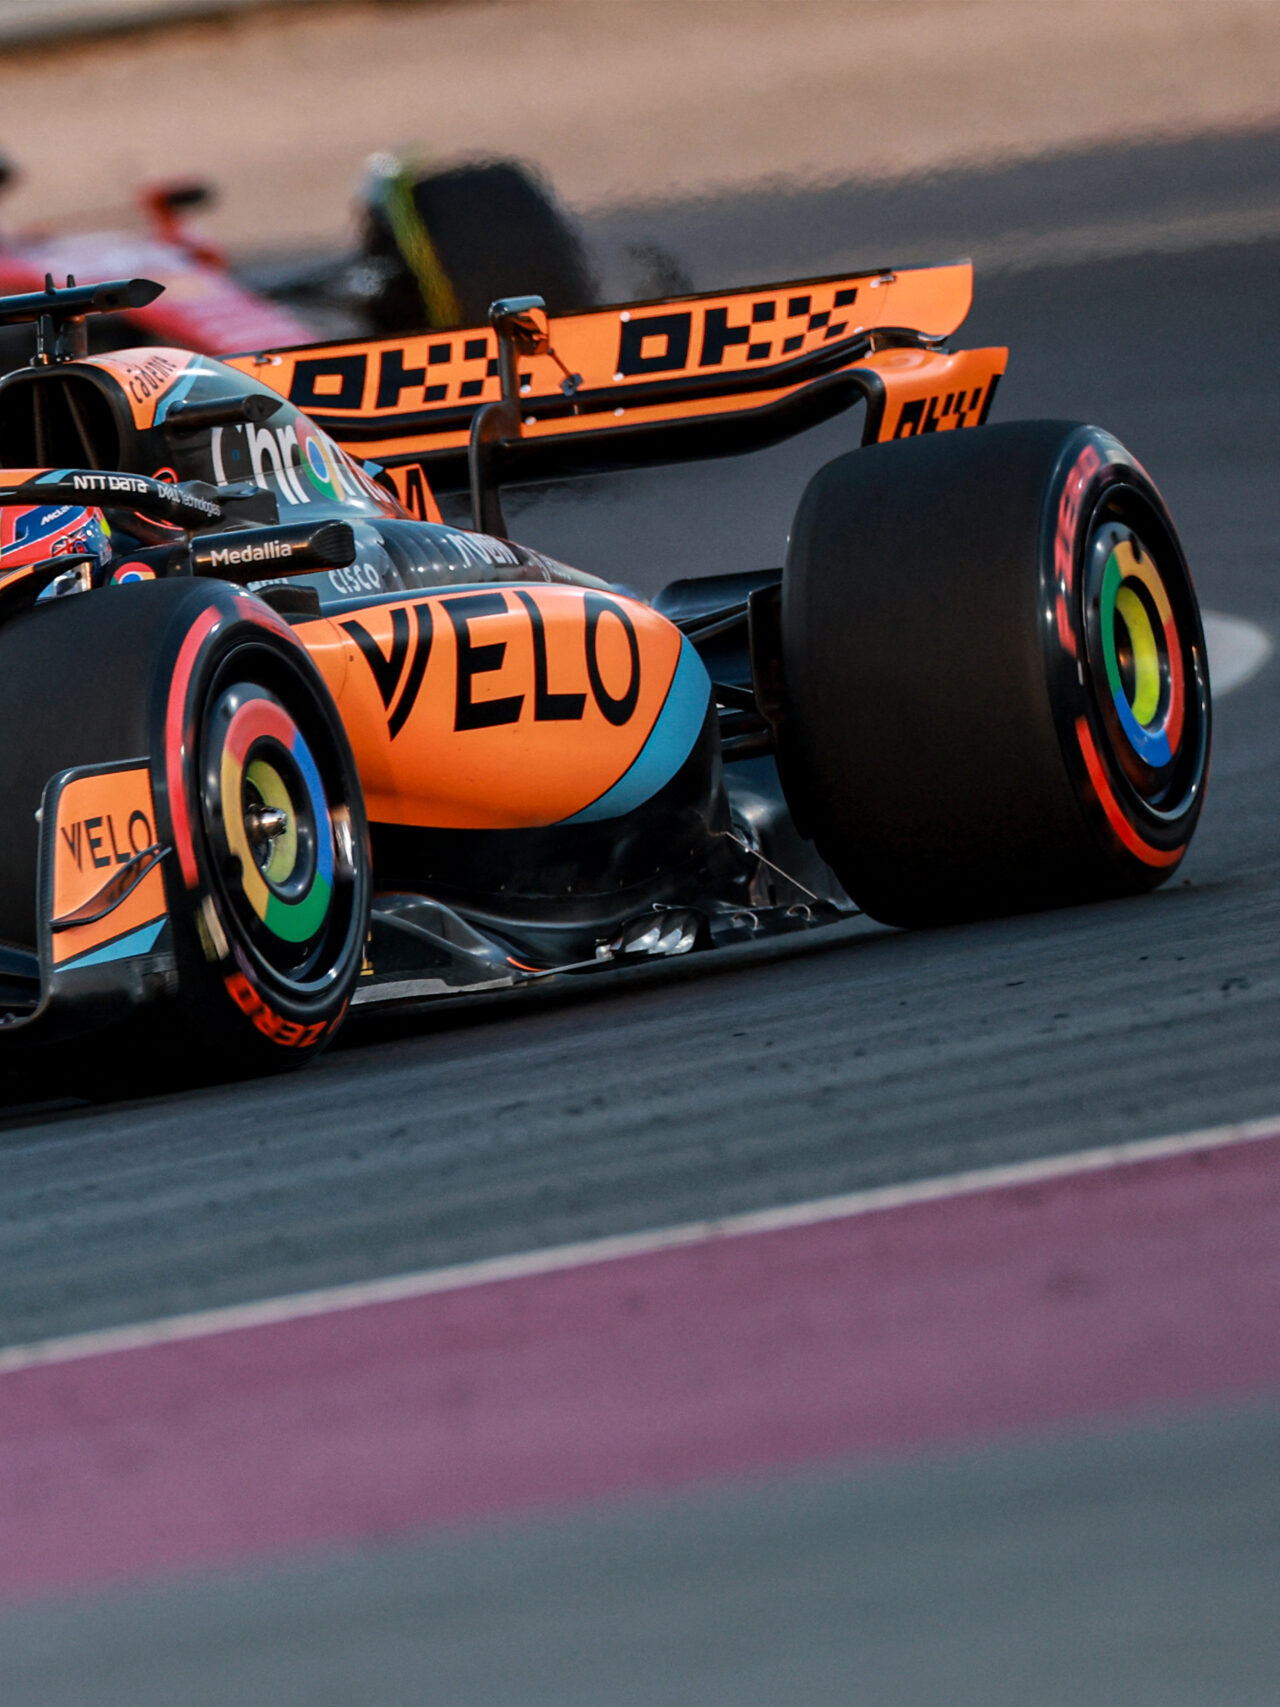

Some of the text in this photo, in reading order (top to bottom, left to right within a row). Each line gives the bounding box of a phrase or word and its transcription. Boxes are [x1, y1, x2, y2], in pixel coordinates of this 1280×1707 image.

[618, 288, 859, 376] OKX
[74, 476, 106, 490] NTT
[210, 540, 292, 567] Medallia
[338, 590, 641, 742] VELO
[60, 809, 154, 875] VELO
[224, 971, 328, 1048] ZERO
